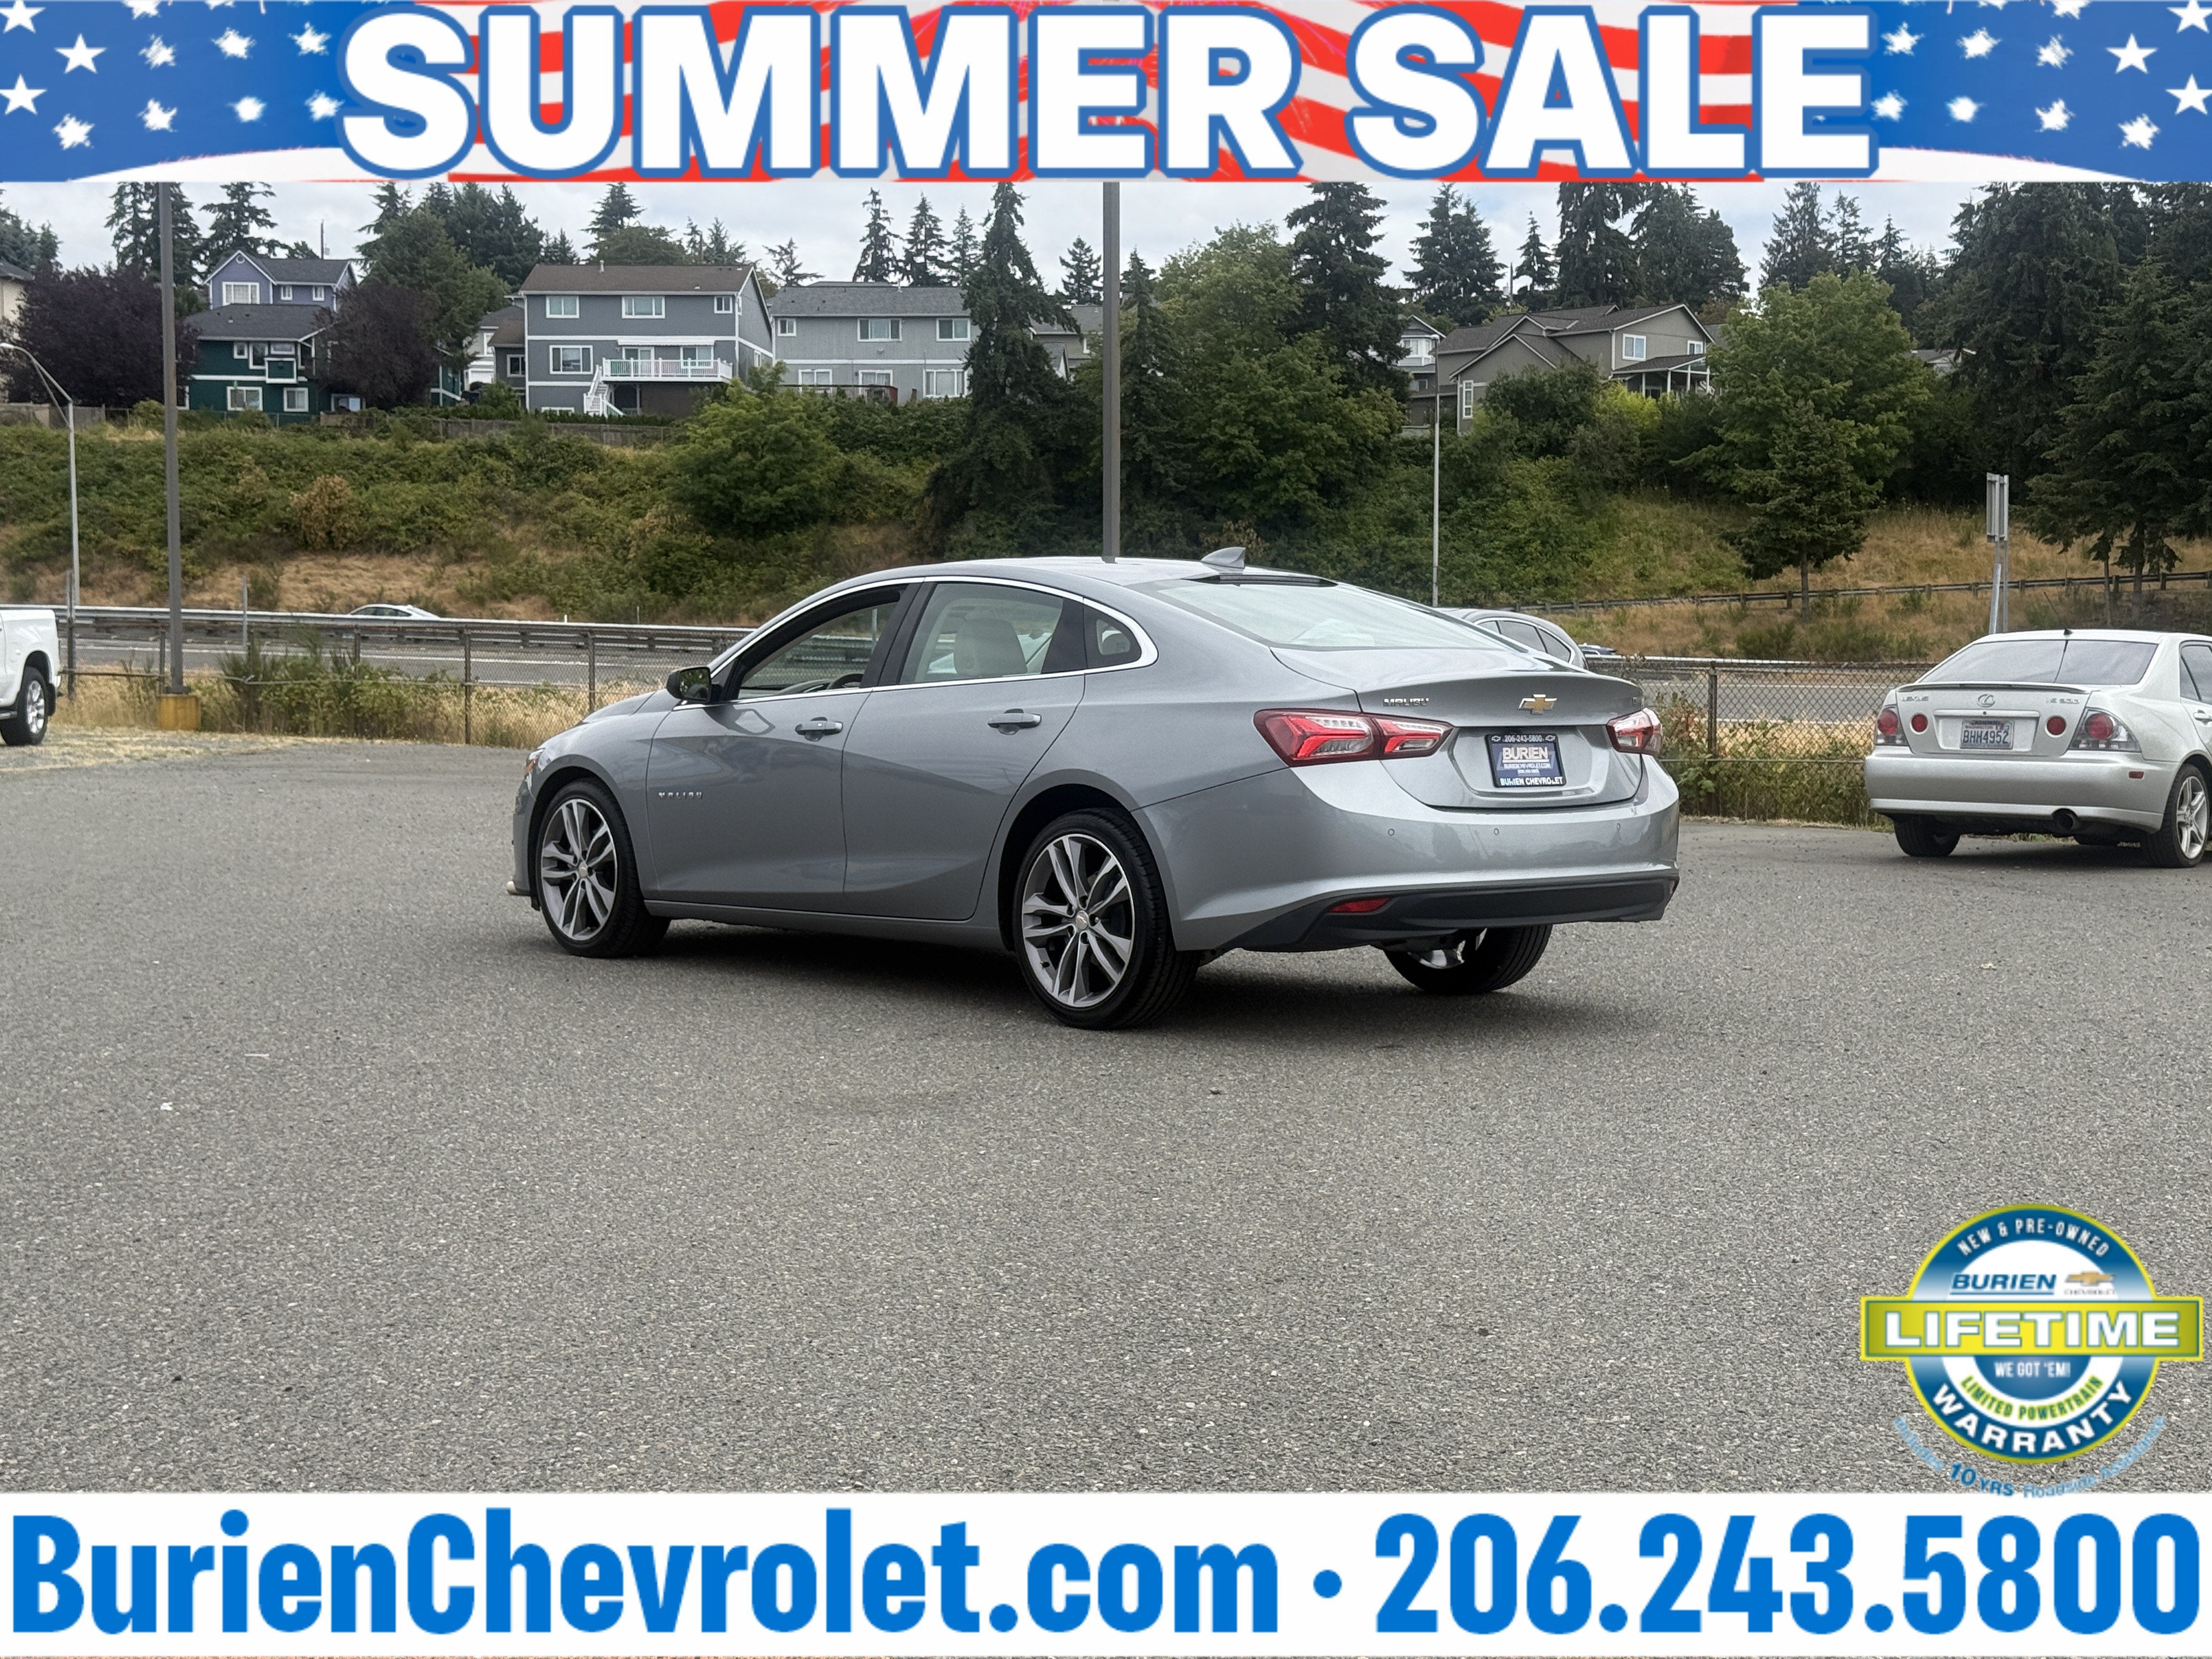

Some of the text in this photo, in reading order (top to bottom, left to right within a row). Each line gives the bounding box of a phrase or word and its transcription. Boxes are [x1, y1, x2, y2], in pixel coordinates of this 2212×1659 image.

[1383, 697, 1430, 707] MALIBU
[1963, 730, 2009, 743] BHH4952
[1502, 746, 1549, 760] BURIEN
[1499, 776, 1563, 786] BURIEN CHEVROLET
